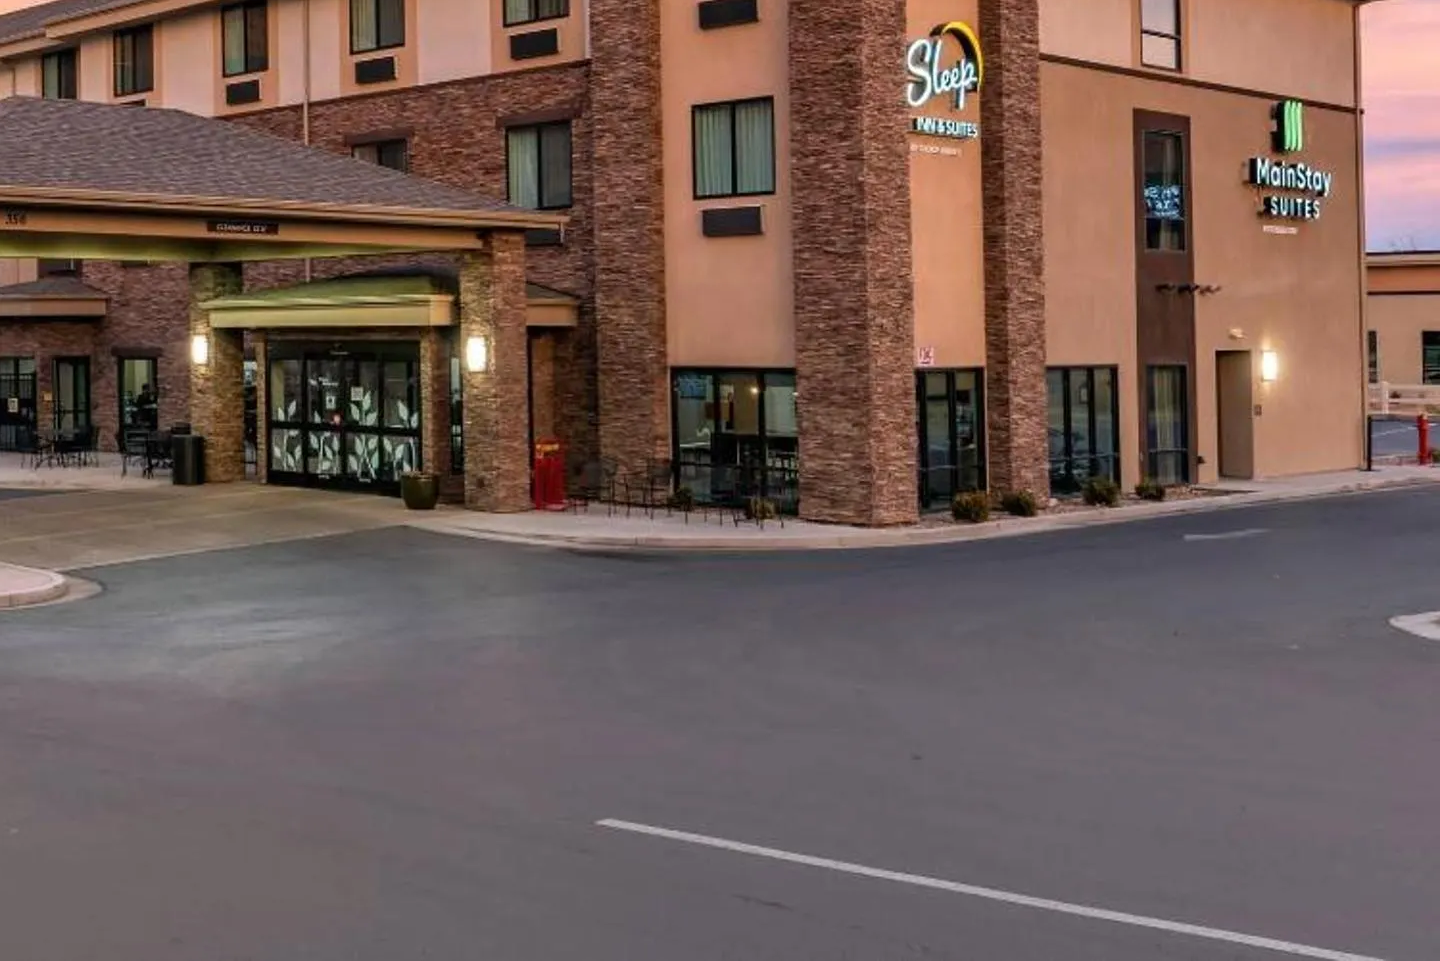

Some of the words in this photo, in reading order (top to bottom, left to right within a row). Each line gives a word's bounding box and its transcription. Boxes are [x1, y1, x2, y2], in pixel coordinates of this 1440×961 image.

[907, 38, 978, 110] Sleep
[946, 120, 978, 138] SUITES
[1256, 156, 1331, 197] MainStay
[1270, 196, 1321, 220] SUITES
